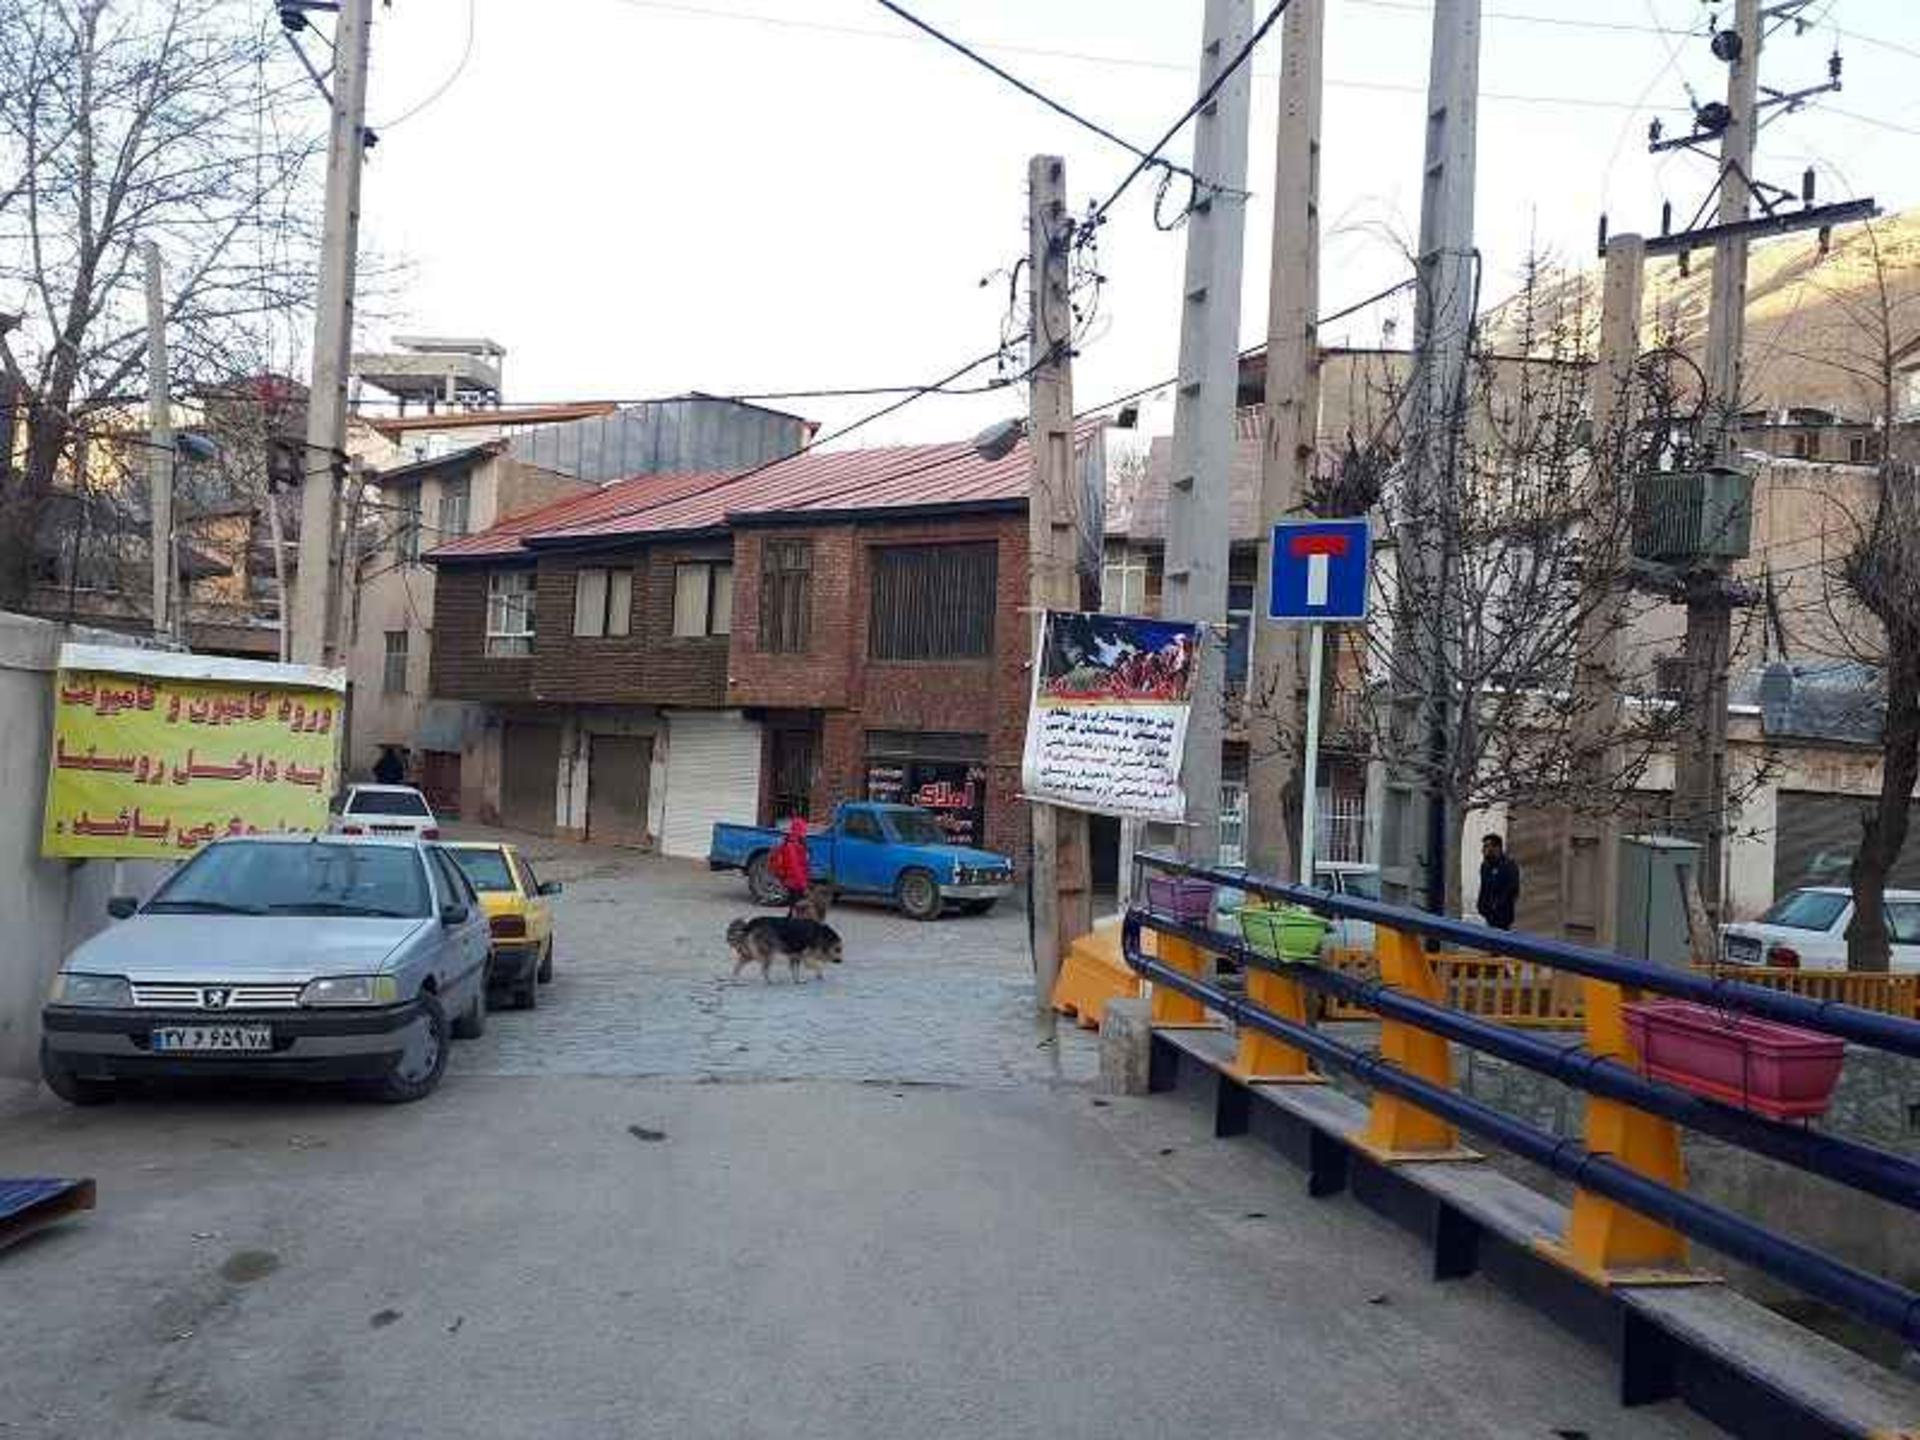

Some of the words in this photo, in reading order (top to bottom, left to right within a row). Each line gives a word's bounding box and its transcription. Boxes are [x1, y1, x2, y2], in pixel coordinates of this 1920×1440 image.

[167, 694, 181, 723] و
[189, 691, 270, 726] کامیون
[277, 695, 332, 734] ورود
[1137, 715, 1155, 726] توجه
[56, 736, 165, 785] روستا
[172, 748, 277, 786] داخل
[284, 761, 325, 793] به
